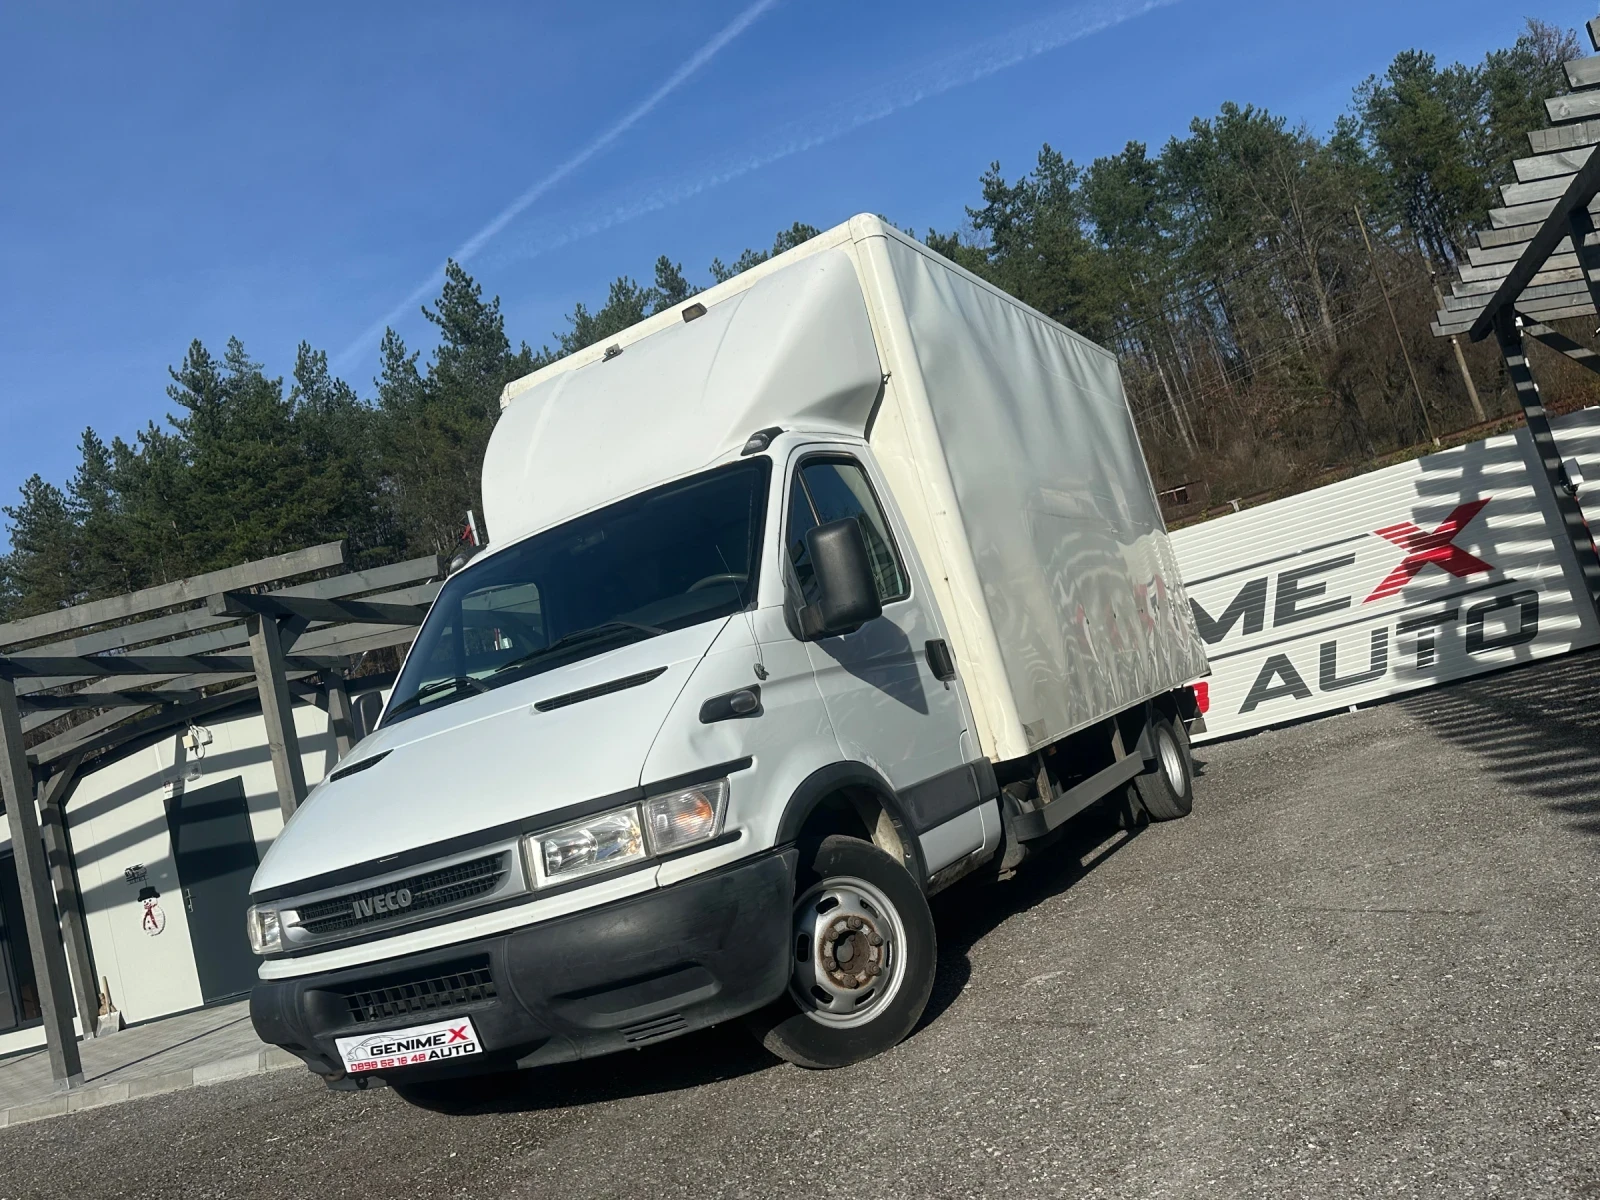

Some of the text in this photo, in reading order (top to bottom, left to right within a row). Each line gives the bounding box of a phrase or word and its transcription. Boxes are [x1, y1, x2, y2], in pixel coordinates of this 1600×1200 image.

[1238, 589, 1539, 714] AUTO
[352, 888, 412, 918] IVECO
[370, 1025, 469, 1056] GENIMEX
[428, 1042, 476, 1060] AUTO
[350, 1061, 379, 1072] 0898
[380, 1058, 395, 1068] 62
[410, 1053, 426, 1063] 48
